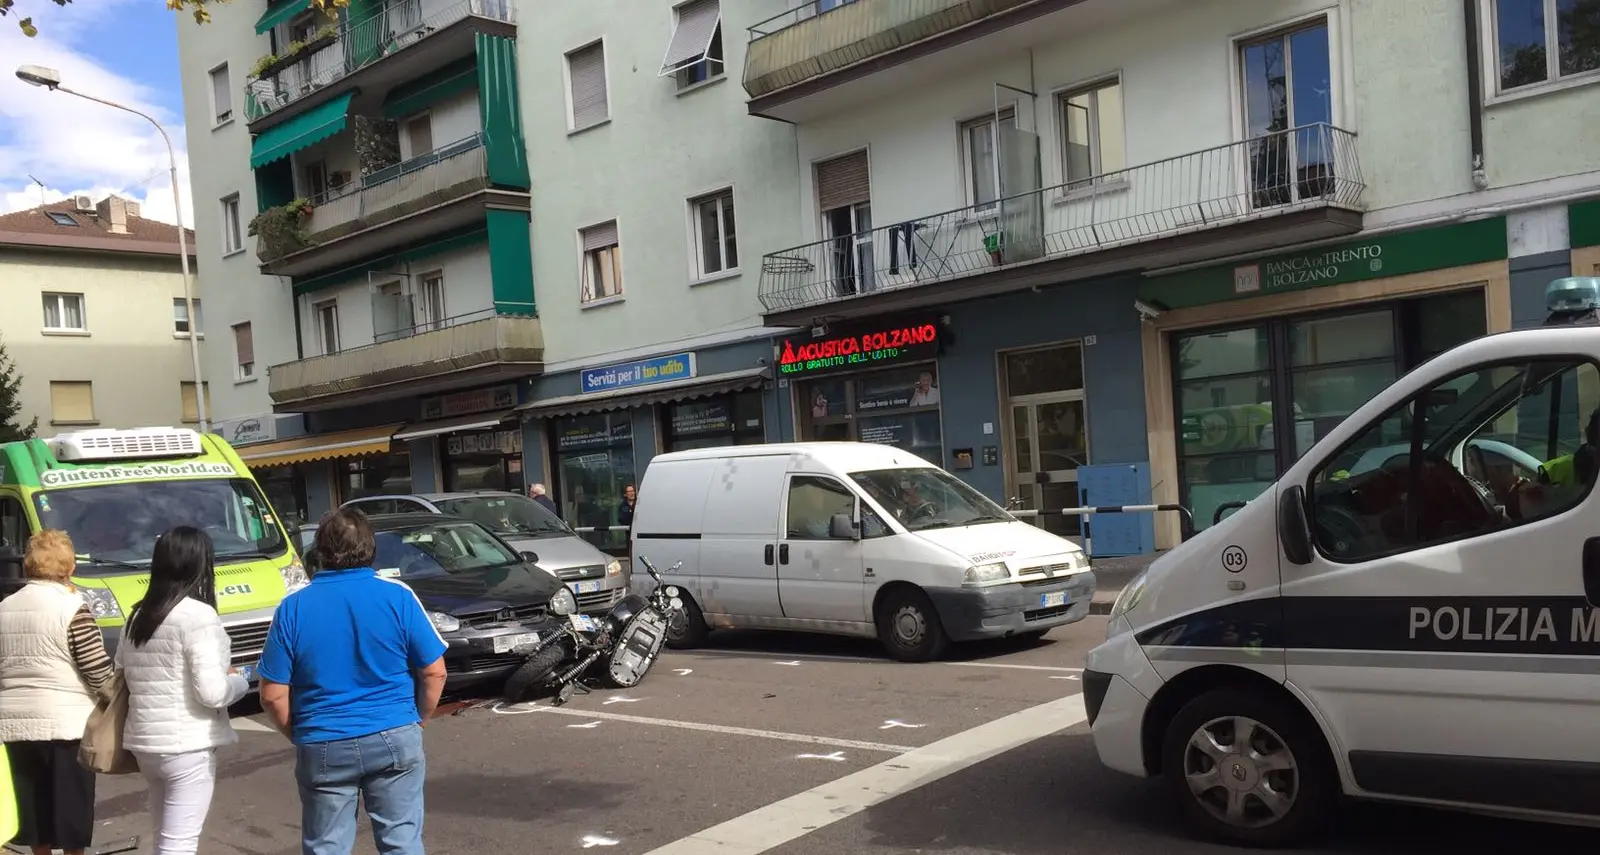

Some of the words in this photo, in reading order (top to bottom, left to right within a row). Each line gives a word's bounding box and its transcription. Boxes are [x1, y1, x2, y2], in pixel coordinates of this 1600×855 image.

[1266, 256, 1311, 275] BANCA
[1321, 244, 1382, 264] TRENTO
[1273, 266, 1338, 287] BOLZANO
[796, 337, 860, 361] ACUSTICA
[862, 324, 937, 352] BOLZANO
[806, 355, 845, 369] GRATUITO
[847, 347, 898, 363] DELL'UDITO
[587, 370, 616, 387] Servizi
[618, 371, 633, 385] per
[634, 366, 641, 380] il
[643, 366, 658, 379] tuo
[660, 360, 684, 375] udito
[43, 463, 233, 485] GlutenFreeWorld.eu
[1226, 552, 1243, 565] 03
[1408, 606, 1558, 642] POLIZIA
